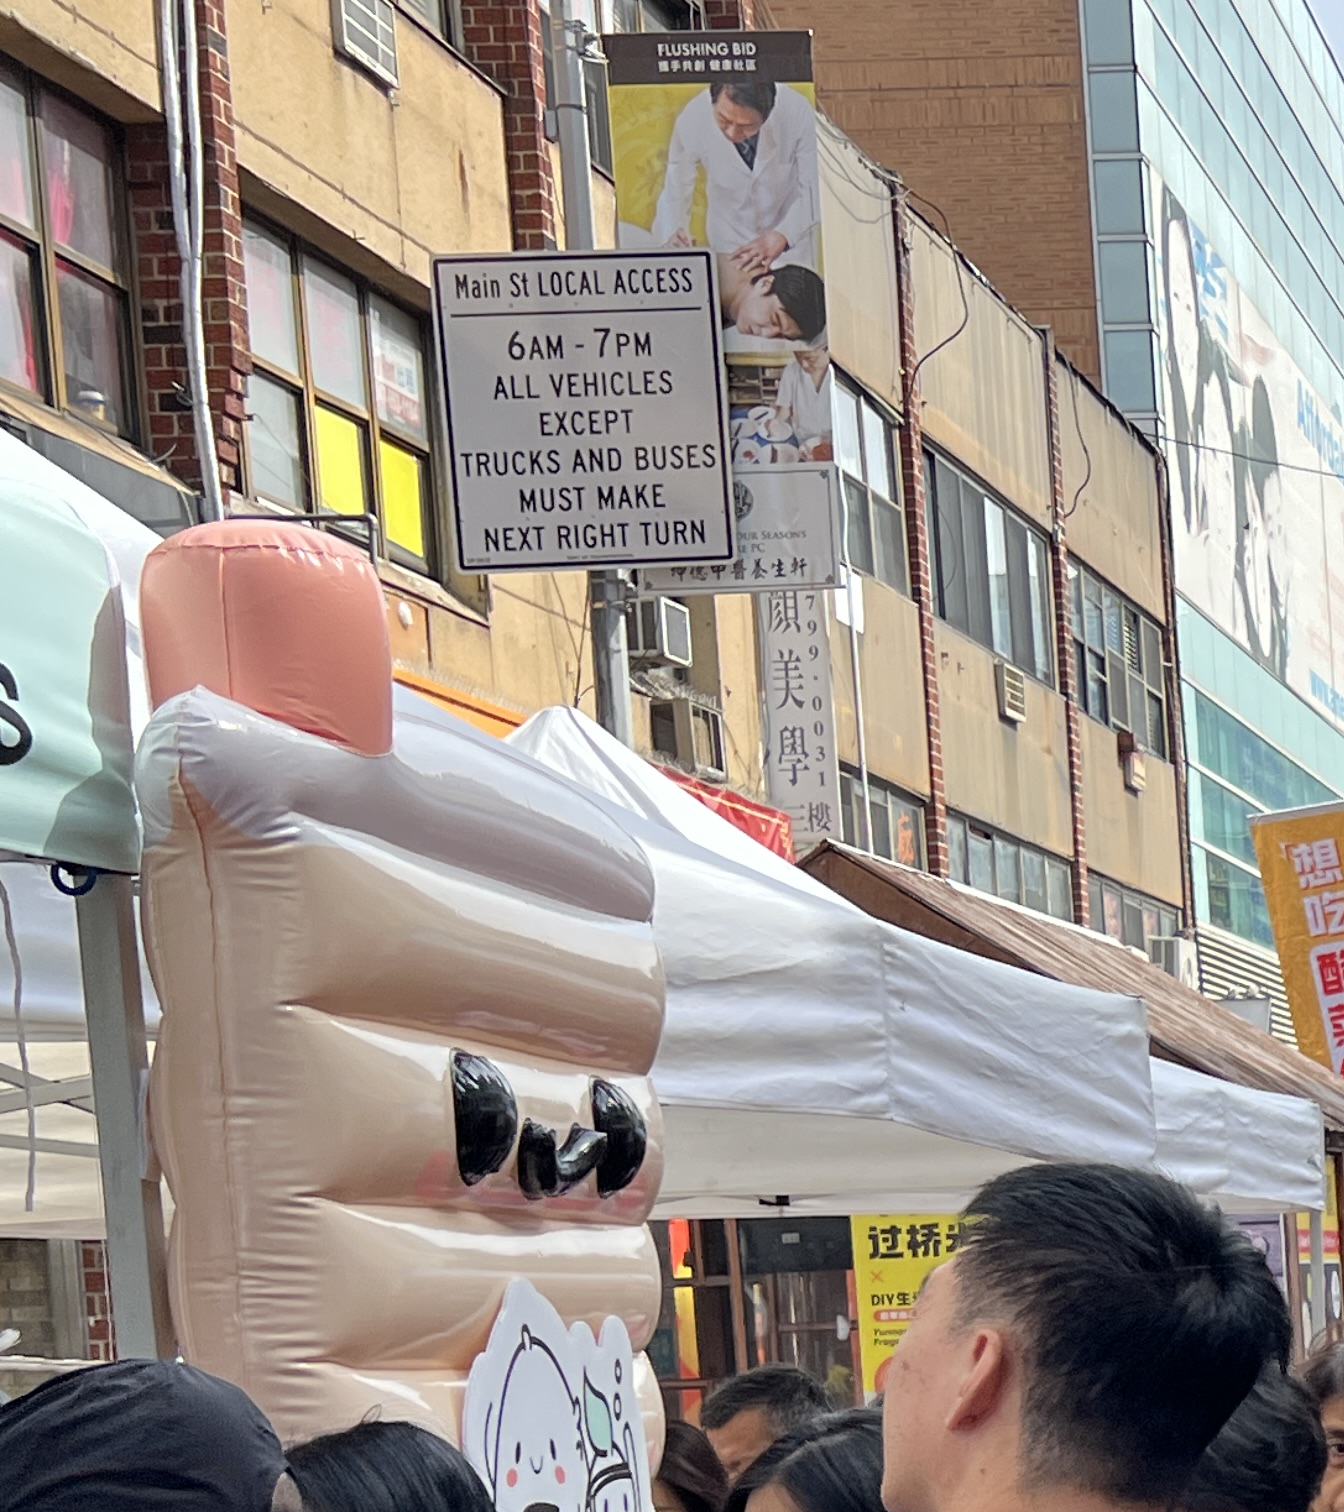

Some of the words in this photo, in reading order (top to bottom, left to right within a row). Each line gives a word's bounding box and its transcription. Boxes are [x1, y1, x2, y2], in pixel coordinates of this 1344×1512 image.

[657, 43, 729, 56] FLUSHING
[733, 42, 756, 55] BID
[455, 273, 501, 299] Main
[510, 272, 530, 298] St
[537, 270, 605, 297] LOCAL
[613, 268, 693, 295] ACCESS
[508, 331, 565, 361] 6AM
[593, 328, 652, 358] 7PM
[493, 375, 540, 400] ALL
[550, 370, 673, 398] VEHICLES
[539, 409, 634, 436] EXCEPT
[461, 449, 561, 478] TRUCKS
[572, 447, 622, 473] AND
[635, 444, 717, 471] BUSES
[519, 486, 585, 513] MUST
[597, 484, 666, 510] MAKE
[484, 525, 544, 552] NEXT
[557, 522, 629, 549] RIGHT
[639, 519, 706, 545] TURN
